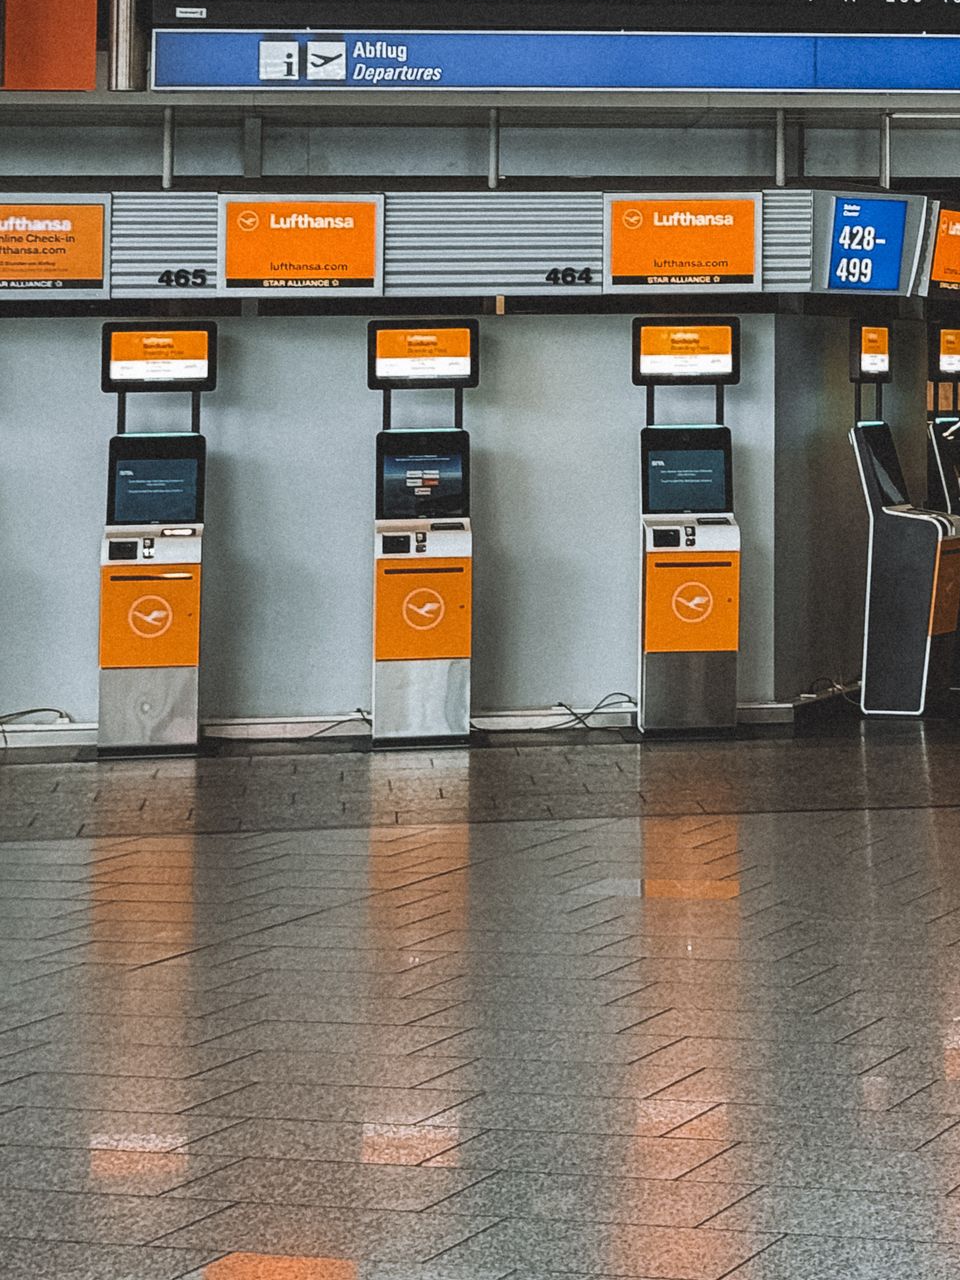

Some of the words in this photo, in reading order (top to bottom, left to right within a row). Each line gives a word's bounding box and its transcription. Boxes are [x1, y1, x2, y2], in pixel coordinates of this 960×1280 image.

[353, 42, 406, 61] Abflug
[353, 64, 441, 83] Departures
[271, 214, 353, 228] Lufthansa
[654, 213, 733, 225] Lufthansa
[26, 234, 75, 243] Check-in
[839, 226, 885, 250] 428-
[270, 262, 348, 272] lufthansa.com
[654, 260, 728, 268] lufthansa.com
[837, 258, 871, 282] 499
[158, 270, 207, 287] 465
[545, 268, 594, 284] 464
